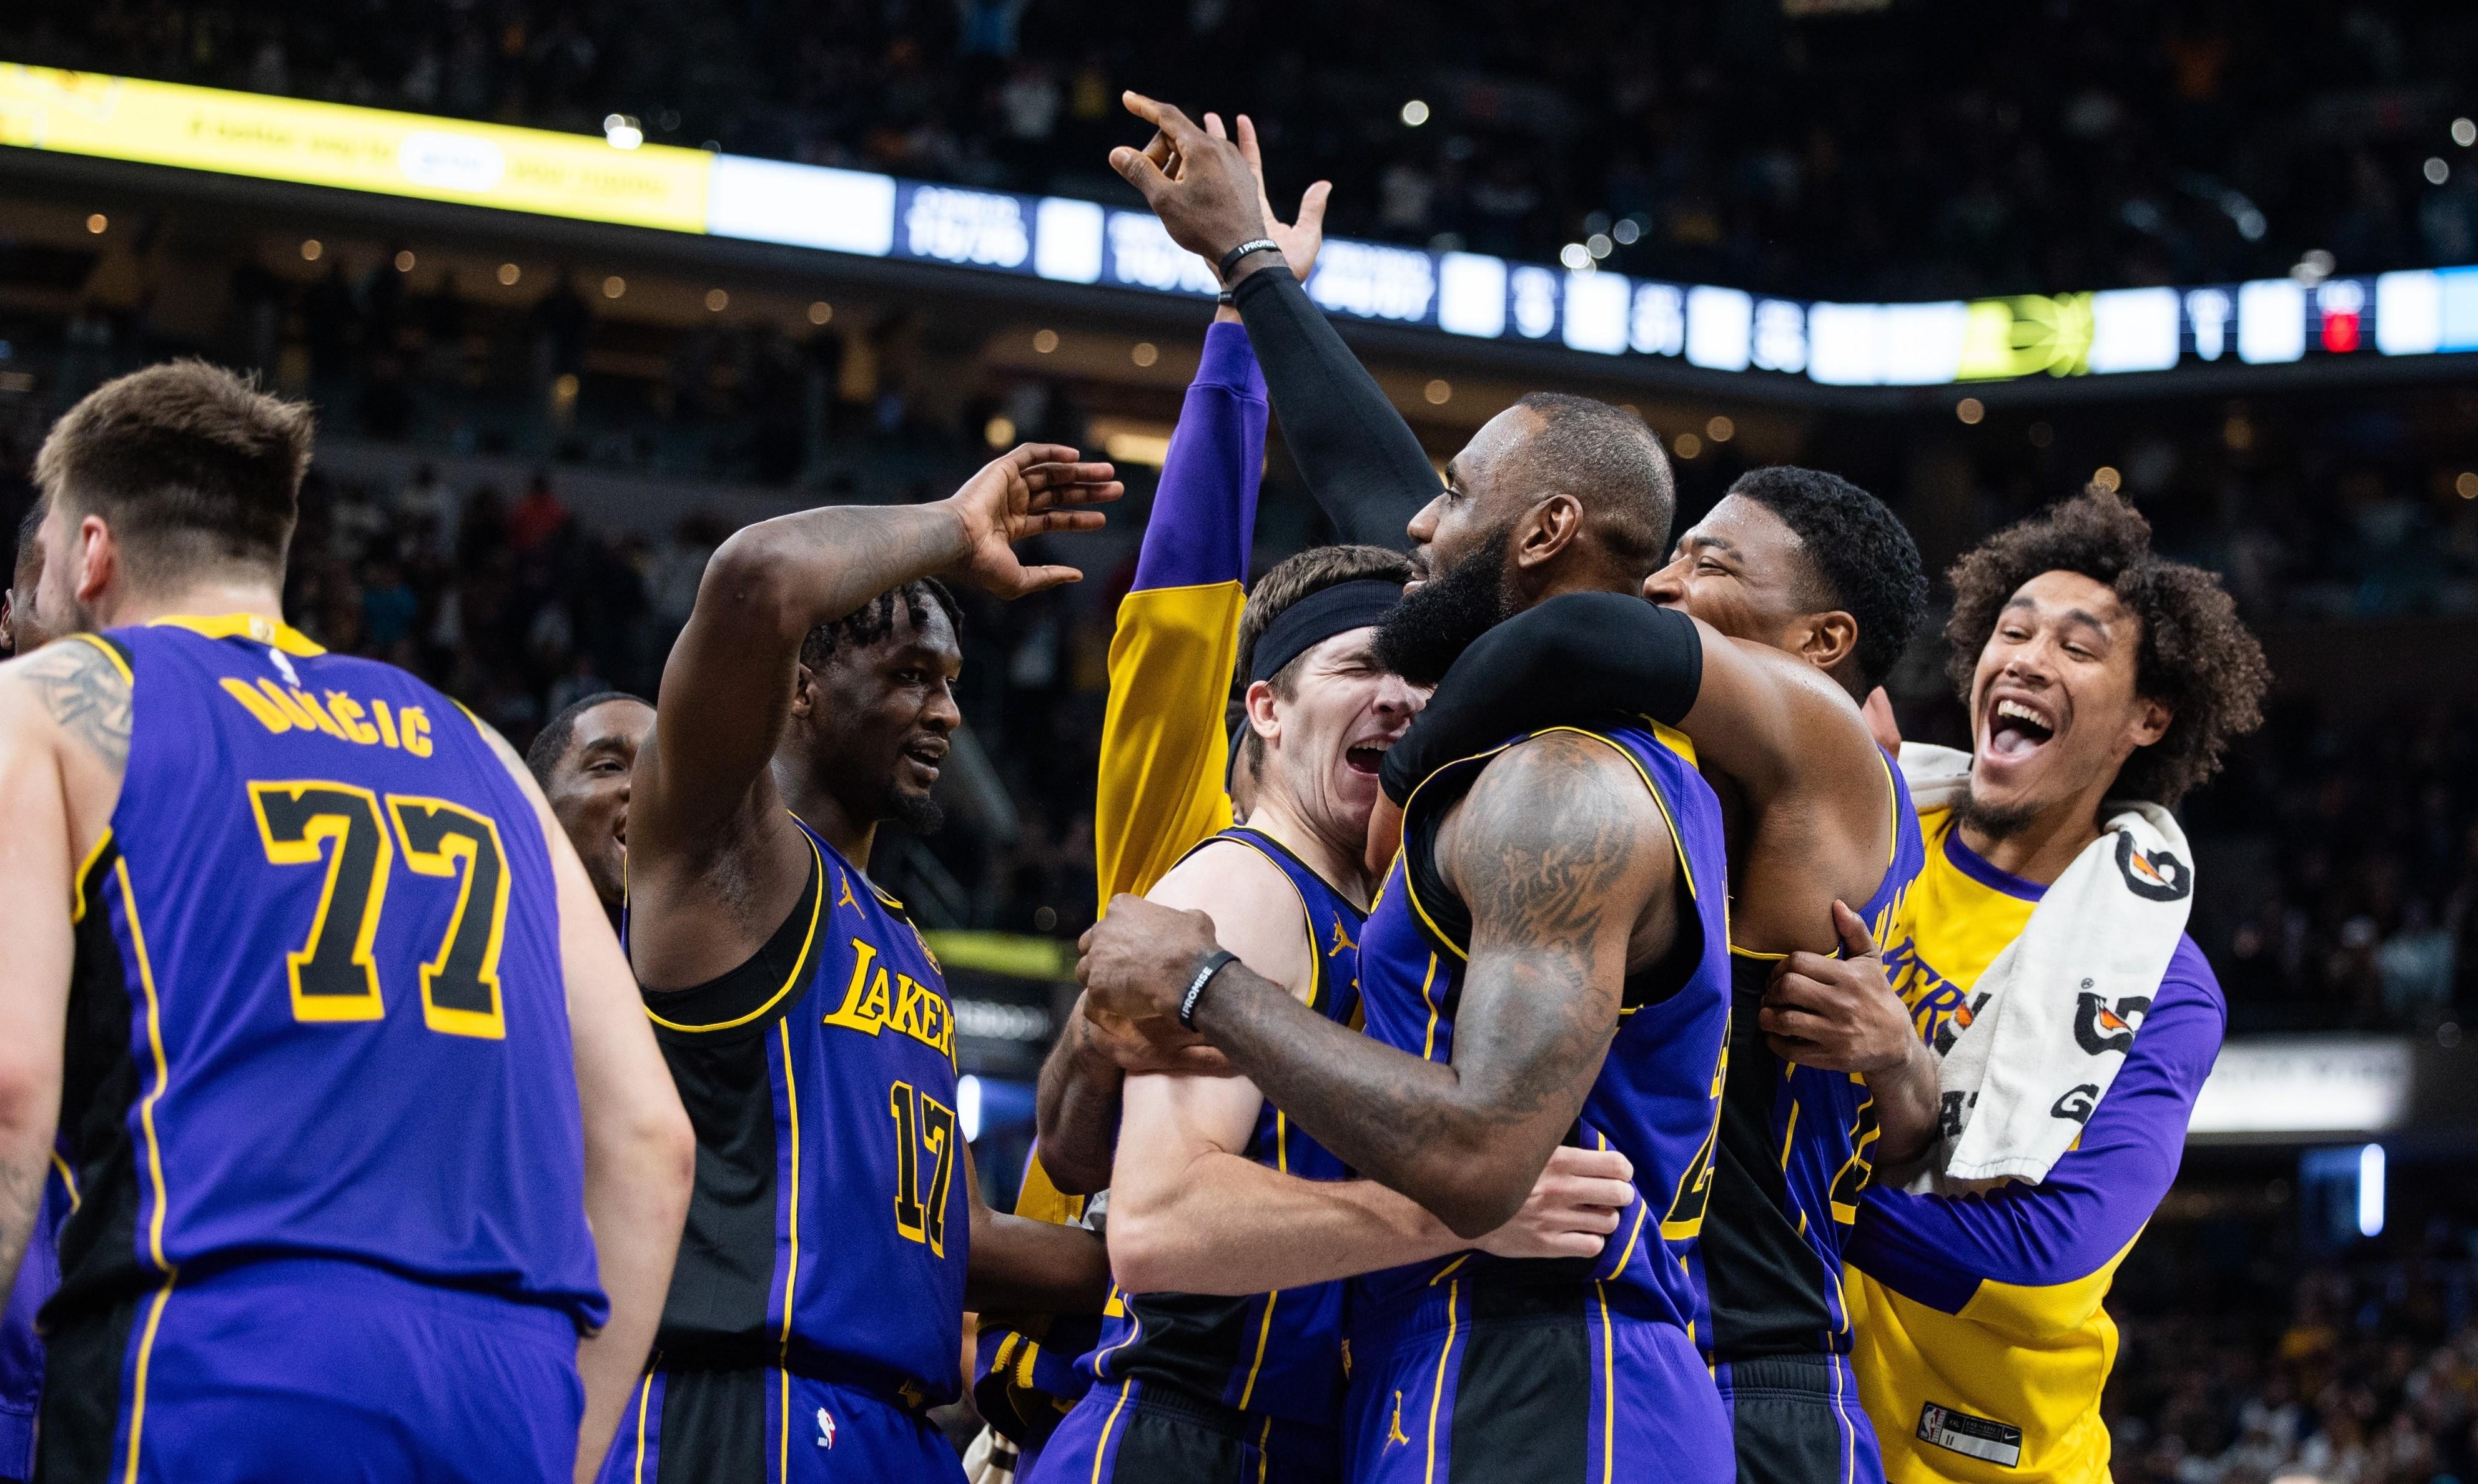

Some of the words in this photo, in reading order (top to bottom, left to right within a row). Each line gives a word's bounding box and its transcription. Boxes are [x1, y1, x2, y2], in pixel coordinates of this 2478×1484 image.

[247, 780, 512, 1040] 77
[822, 936, 958, 1078] LAKER
[1182, 966, 1213, 1014] PROMISE
[891, 1080, 955, 1259] 17
[817, 1437, 828, 1447] NBA
